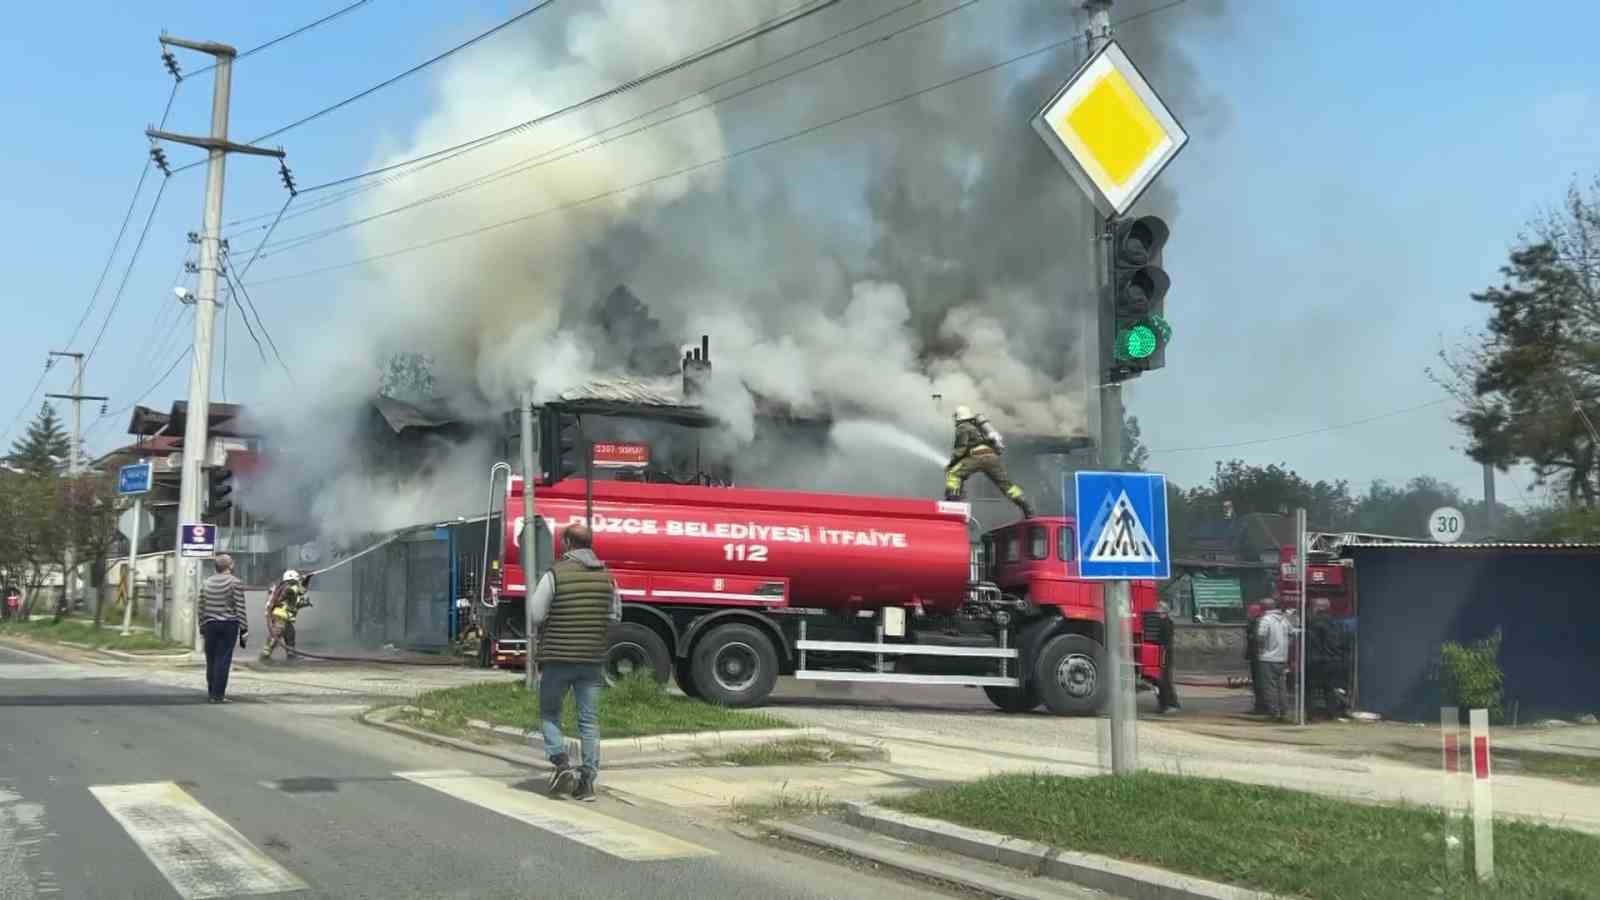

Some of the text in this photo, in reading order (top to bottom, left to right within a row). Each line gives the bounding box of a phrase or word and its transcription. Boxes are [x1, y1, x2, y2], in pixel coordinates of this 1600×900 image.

[665, 519, 812, 543] BELEDİYESİ
[819, 527, 908, 548] İTFAİYE
[1438, 515, 1458, 533] 30
[723, 543, 768, 562] 112
